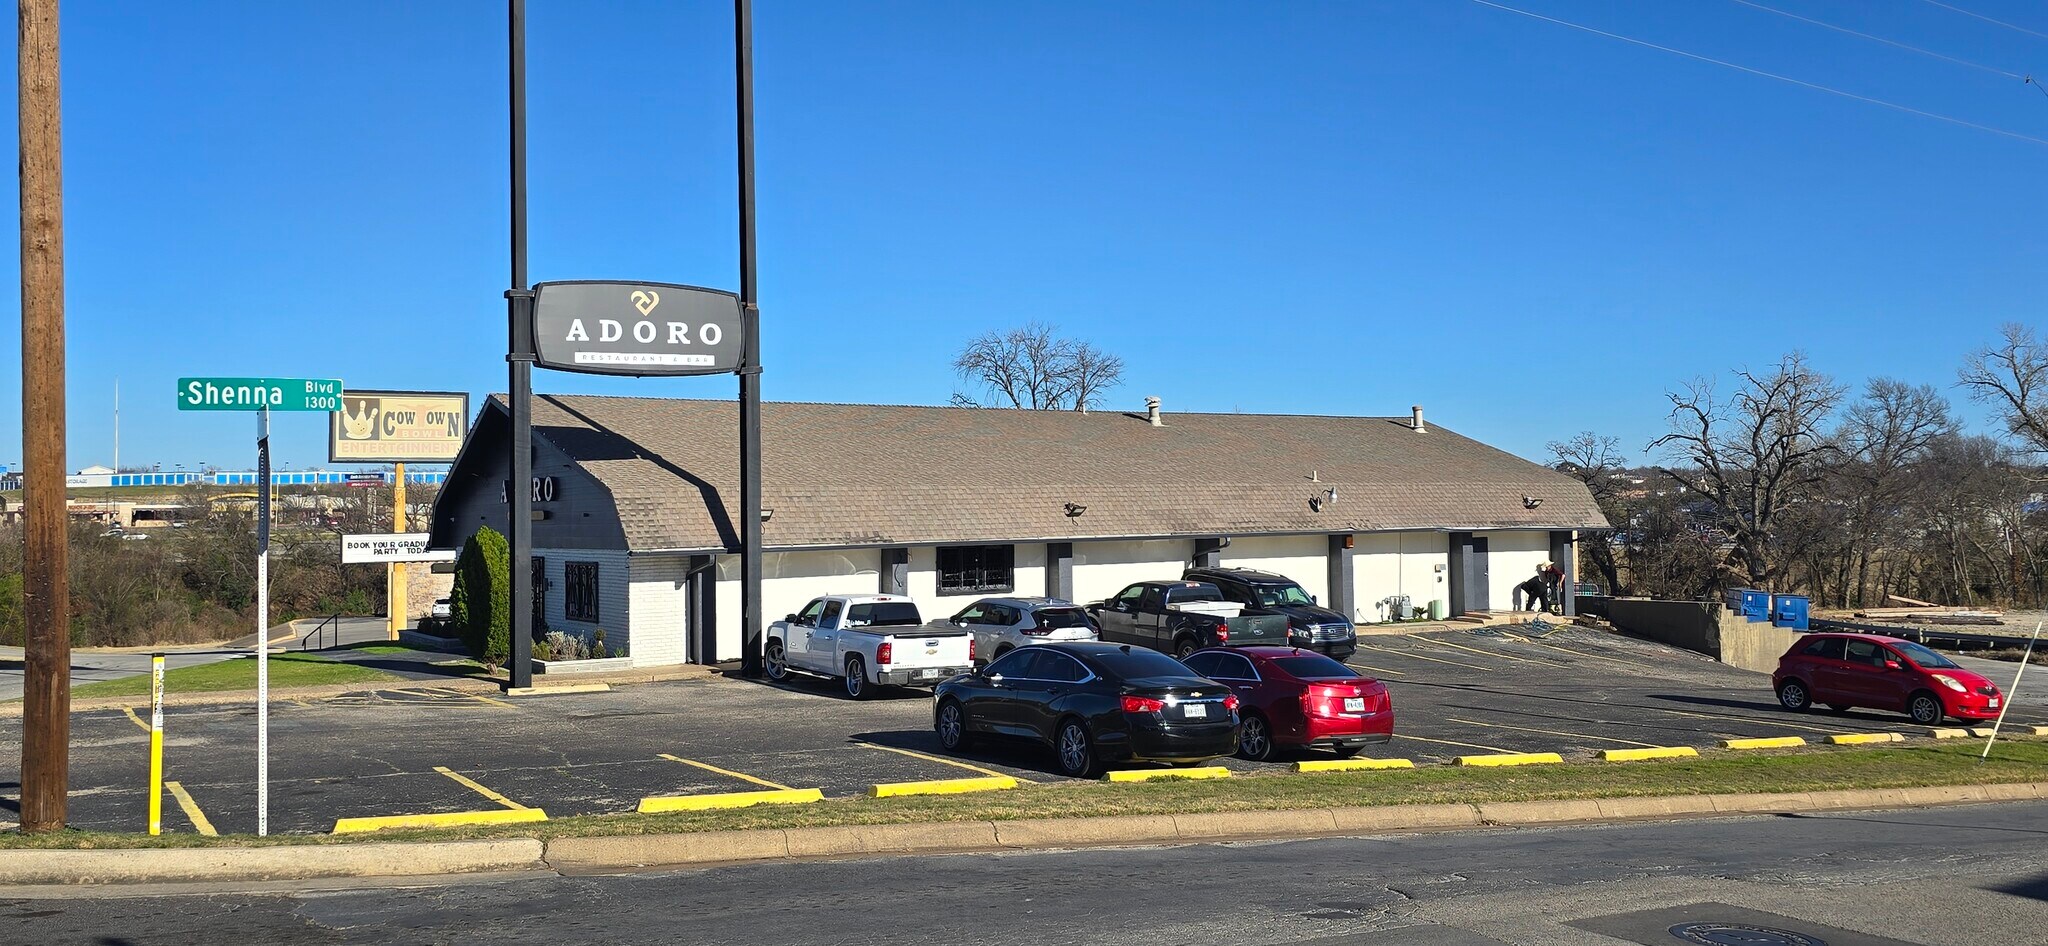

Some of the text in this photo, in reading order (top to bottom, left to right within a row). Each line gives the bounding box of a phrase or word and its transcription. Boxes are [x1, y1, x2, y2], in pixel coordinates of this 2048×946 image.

[566, 318, 723, 346] ADORO
[582, 354, 663, 362] RESTAURANT
[187, 381, 334, 405] Shenna Blvd
[304, 397, 336, 409] 1300
[402, 430, 442, 438] BOWL
[341, 442, 458, 454] ENTERTAINMENT
[500, 476, 553, 503] ARO
